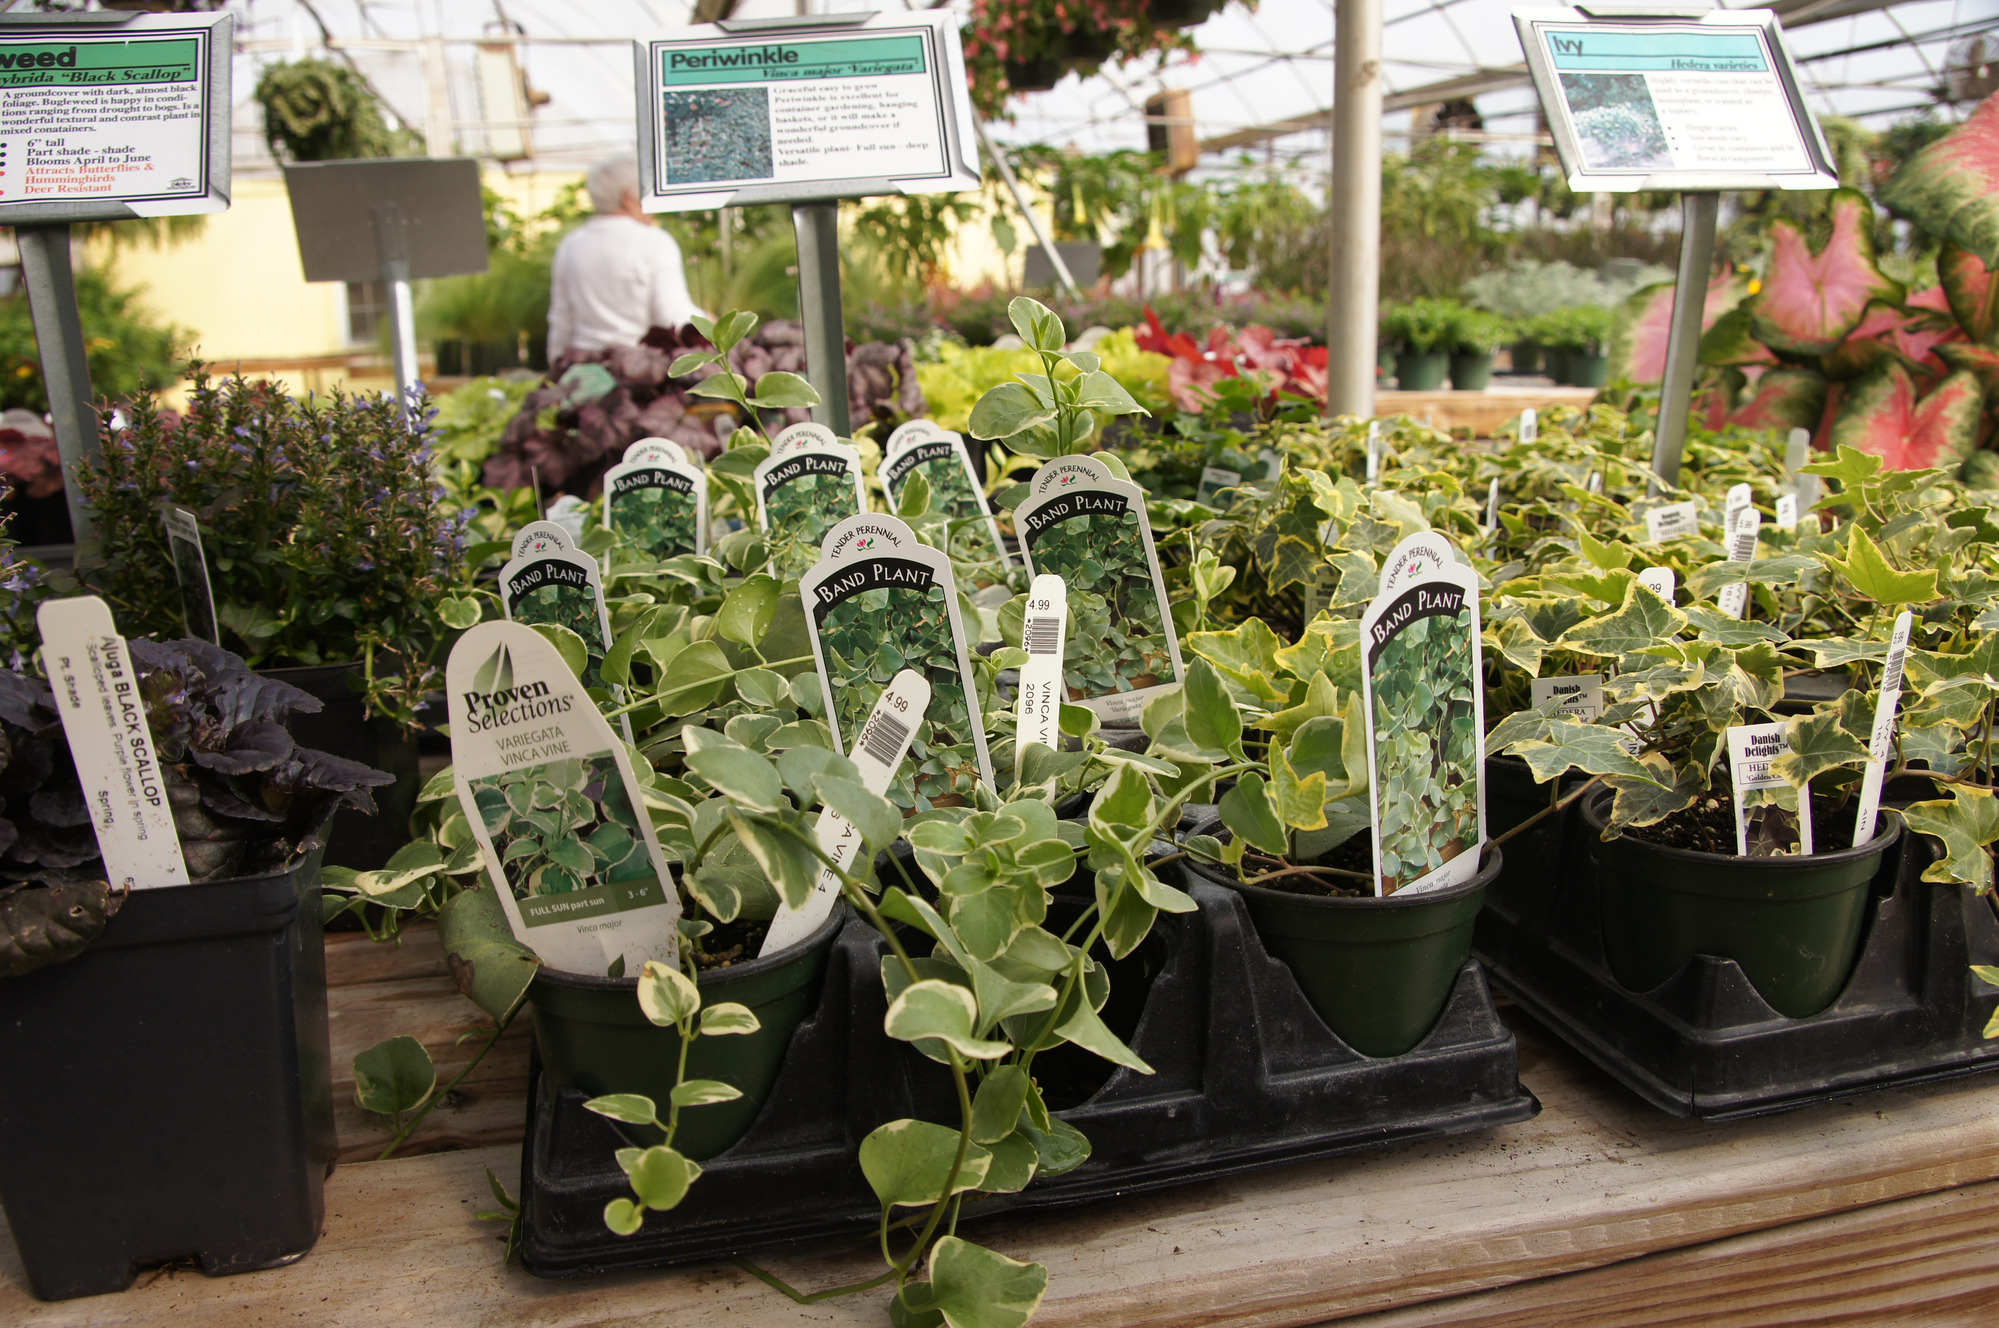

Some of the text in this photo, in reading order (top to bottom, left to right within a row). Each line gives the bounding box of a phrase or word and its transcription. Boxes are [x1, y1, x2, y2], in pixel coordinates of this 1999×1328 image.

[1552, 35, 1583, 57] Ivy
[670, 46, 799, 70] Periwinkle
[1671, 59, 1758, 71] Hedera varieties
[62, 71, 116, 83] “Black
[121, 67, 191, 82] Scallop”
[762, 67, 799, 79] Vinca
[802, 65, 844, 79] major
[2, 94, 188, 108] foliage. Bugleweed is happy in condi-
[3, 84, 197, 99] A groundcover with dark, almost black
[2, 108, 27, 117] tions
[29, 106, 70, 116] ranging
[71, 106, 97, 114] from
[99, 105, 141, 114] drought
[154, 103, 180, 112] bogs.
[182, 102, 192, 110] Is
[879, 101, 919, 109] hanging
[1, 110, 200, 126] wonderful textural and contrast plant in
[829, 122, 890, 133] groundcover
[0, 126, 32, 135] mixed
[27, 145, 136, 157] Part shade shade
[45, 138, 65, 147] tall
[26, 154, 152, 167] Blooms April to June
[26, 162, 155, 175] Attracts Butterflies &
[24, 183, 112, 195] Deer Resistant
[25, 174, 116, 185] Hummingbirds
[766, 456, 846, 486] BAND PLANT
[887, 445, 951, 480] BAND PLANT
[616, 470, 691, 492] BAND PLANT
[1038, 464, 1100, 495] TENDER PERENNIAL
[1028, 494, 1125, 531] BAND PLANT
[518, 530, 565, 559] TENDER PERENNIAL
[830, 525, 903, 560] TENDER PERENNIAL
[1386, 545, 1444, 591] TENDER PERENNIAL
[509, 563, 585, 596] BAND PLANT
[817, 563, 930, 604] BAND PLANT
[1029, 598, 1050, 611] 4.99
[1373, 589, 1462, 645] BAND PLANT
[63, 673, 82, 710] Shade
[461, 680, 551, 717] Proven
[1024, 683, 1035, 715] 2096
[1552, 684, 1582, 695] Danish
[885, 690, 909, 713] 4.99
[100, 635, 161, 807] Ajuga BLACK SCALLOP
[1039, 680, 1052, 745] VINCA VI
[86, 643, 109, 694] Scalloped
[113, 732, 127, 766] Purple
[122, 766, 137, 798] flower
[133, 810, 148, 841] spring
[495, 725, 565, 751] VARIEGATA
[1751, 732, 1781, 746] Danish
[500, 740, 572, 767] VINCA VINE
[1748, 762, 1769, 773] HED
[627, 890, 634, 899] 3
[529, 897, 605, 917] FULL SUN part sun
[576, 919, 623, 934] Vinca major
